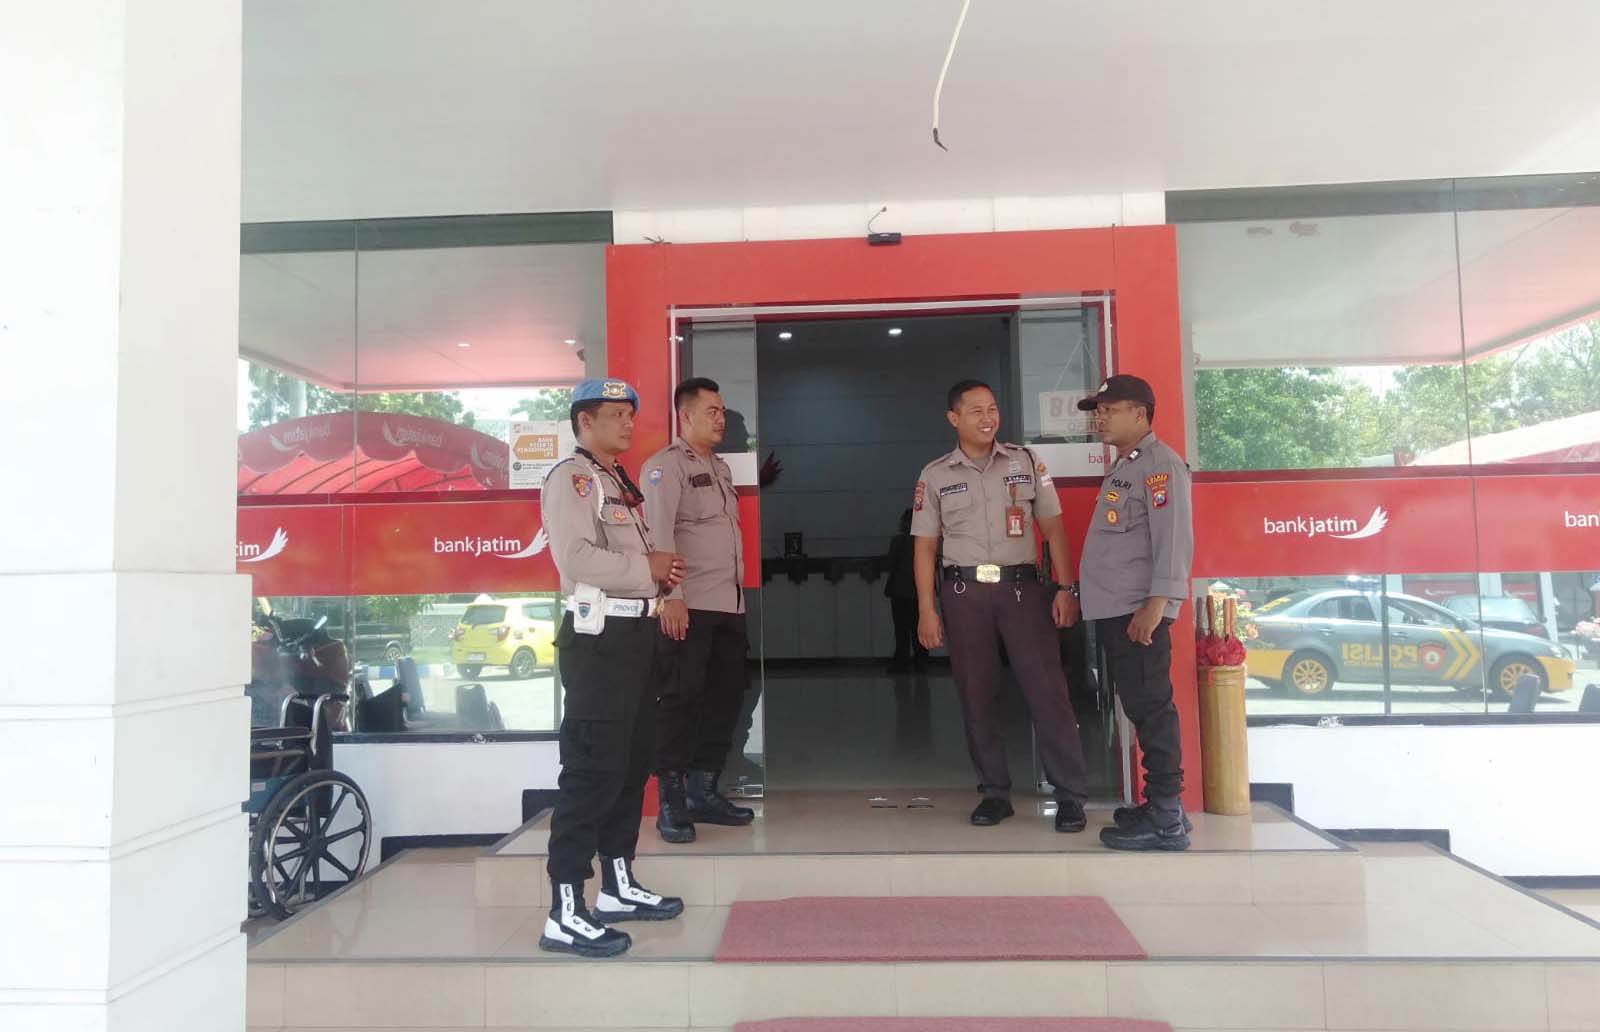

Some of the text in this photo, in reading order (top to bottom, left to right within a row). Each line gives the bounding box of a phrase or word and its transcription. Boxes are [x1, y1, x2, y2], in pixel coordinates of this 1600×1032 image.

[1111, 478, 1132, 491] POLRI
[1264, 516, 1358, 537] bankjatim
[1565, 510, 1600, 528] ban
[434, 536, 521, 557] bankjatim
